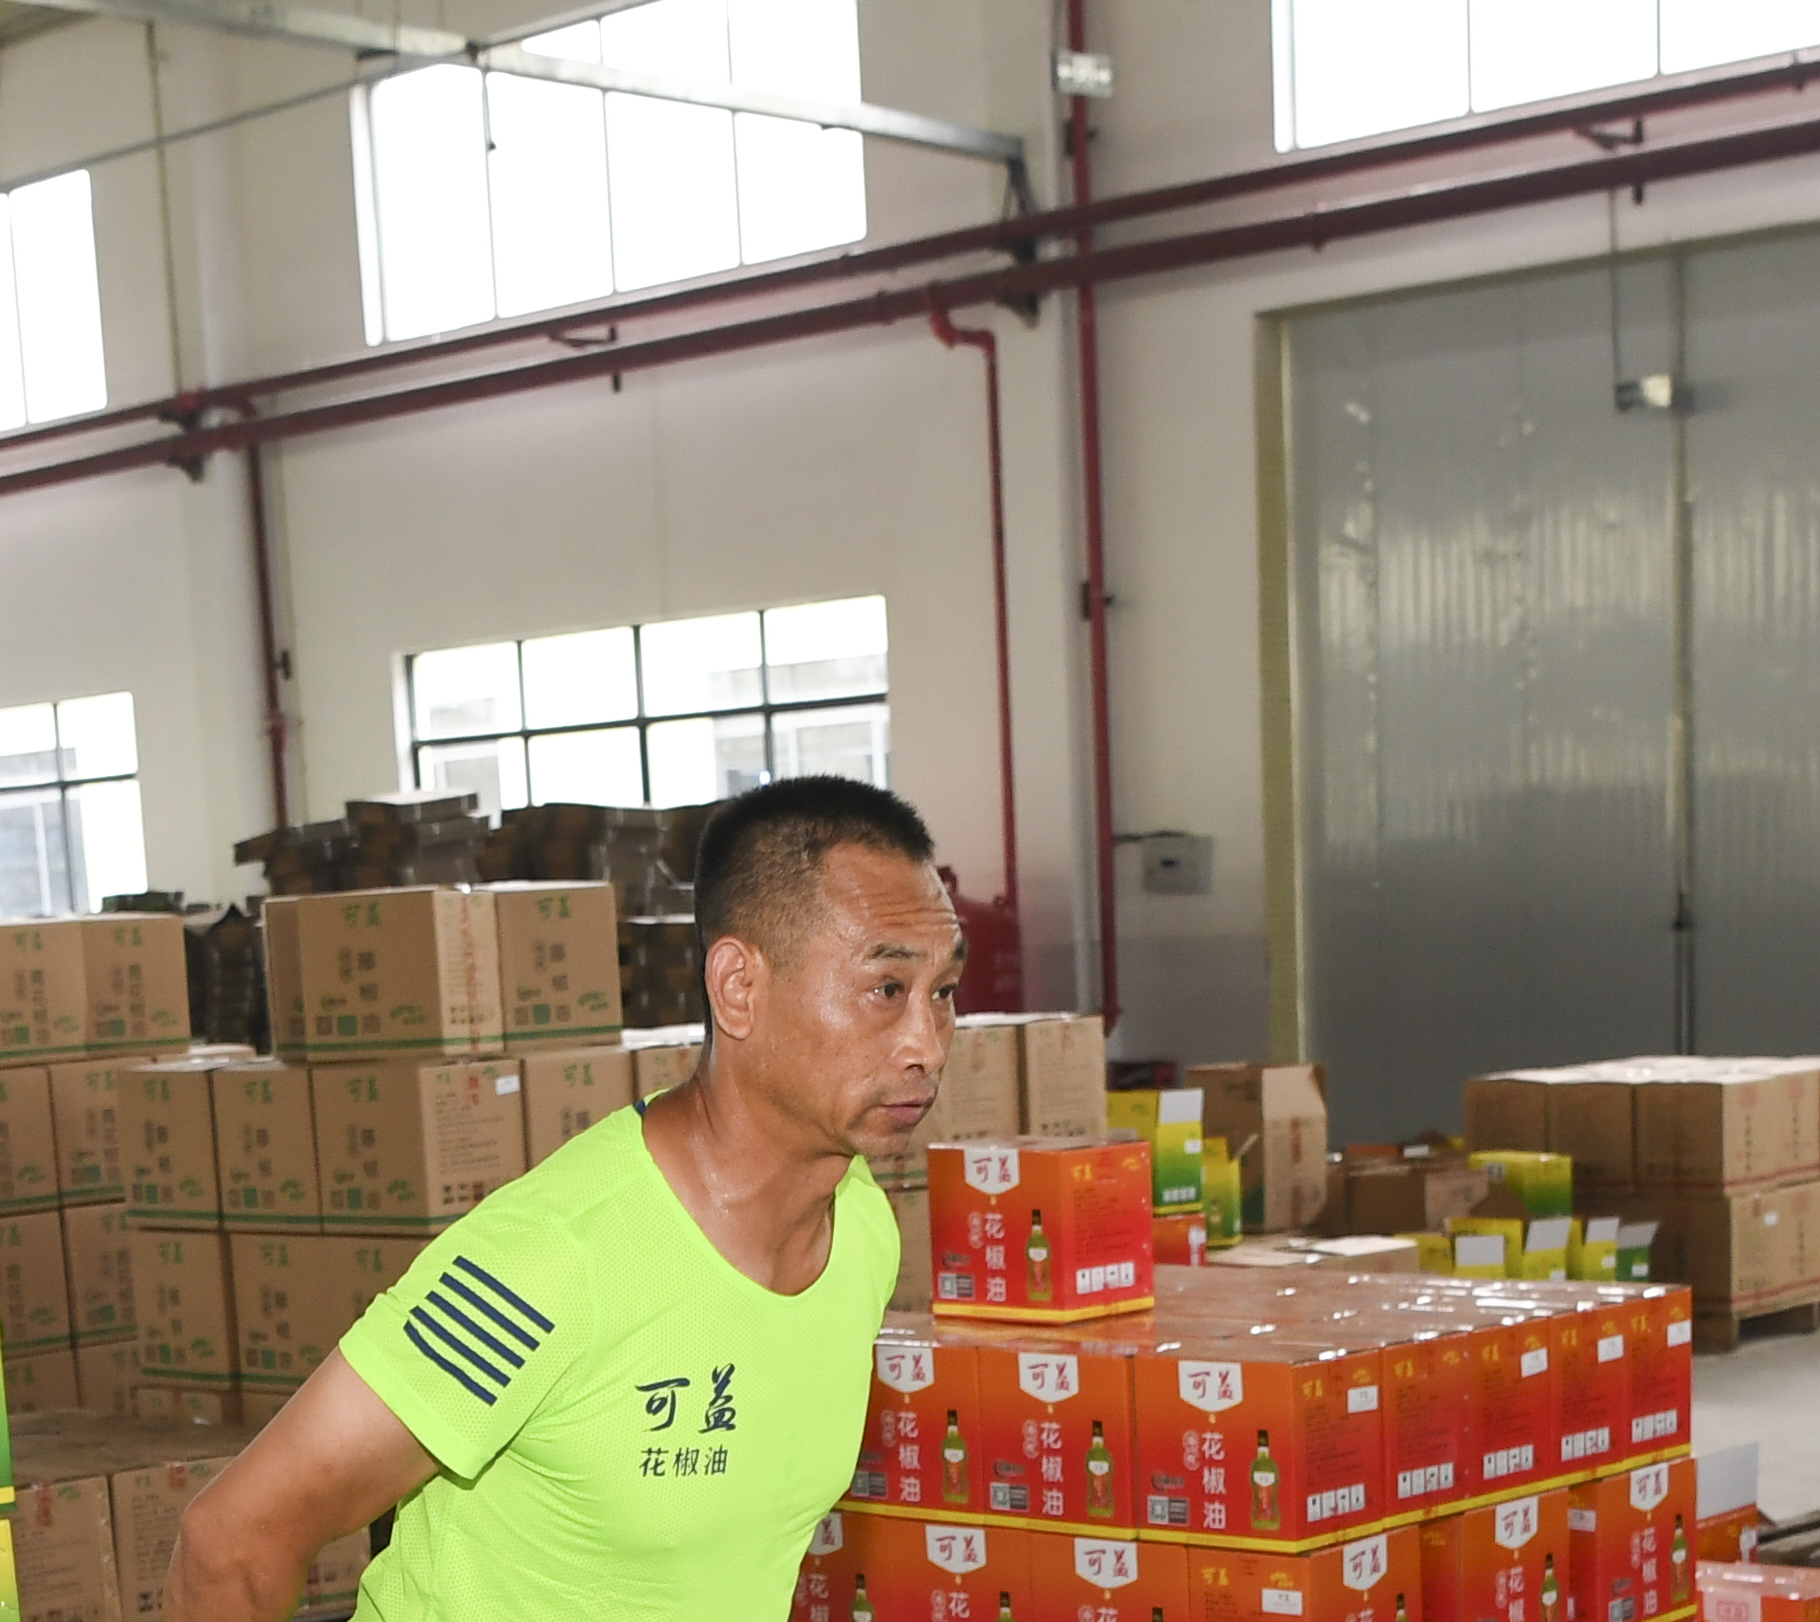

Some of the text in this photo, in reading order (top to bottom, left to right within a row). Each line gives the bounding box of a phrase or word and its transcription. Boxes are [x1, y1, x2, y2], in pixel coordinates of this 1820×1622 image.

[972, 1155, 1011, 1185] 可益
[984, 1213, 1006, 1301] 花椒油
[884, 1354, 926, 1381] 可益
[1027, 1363, 1069, 1392] 可益
[635, 1363, 736, 1433] 可益
[1187, 1370, 1231, 1399] 可益
[639, 1447, 727, 1477] 花椒油
[897, 1412, 921, 1502] 花椒油
[1040, 1422, 1064, 1517] 花椒油
[1201, 1432, 1227, 1530] 花椒油
[1635, 1467, 1663, 1497] 可益
[1500, 1502, 1531, 1536] 可益
[934, 1534, 978, 1563] 可益
[1349, 1544, 1381, 1575] 可益
[1080, 1549, 1128, 1579] 可益
[1640, 1528, 1659, 1616] 花椒油
